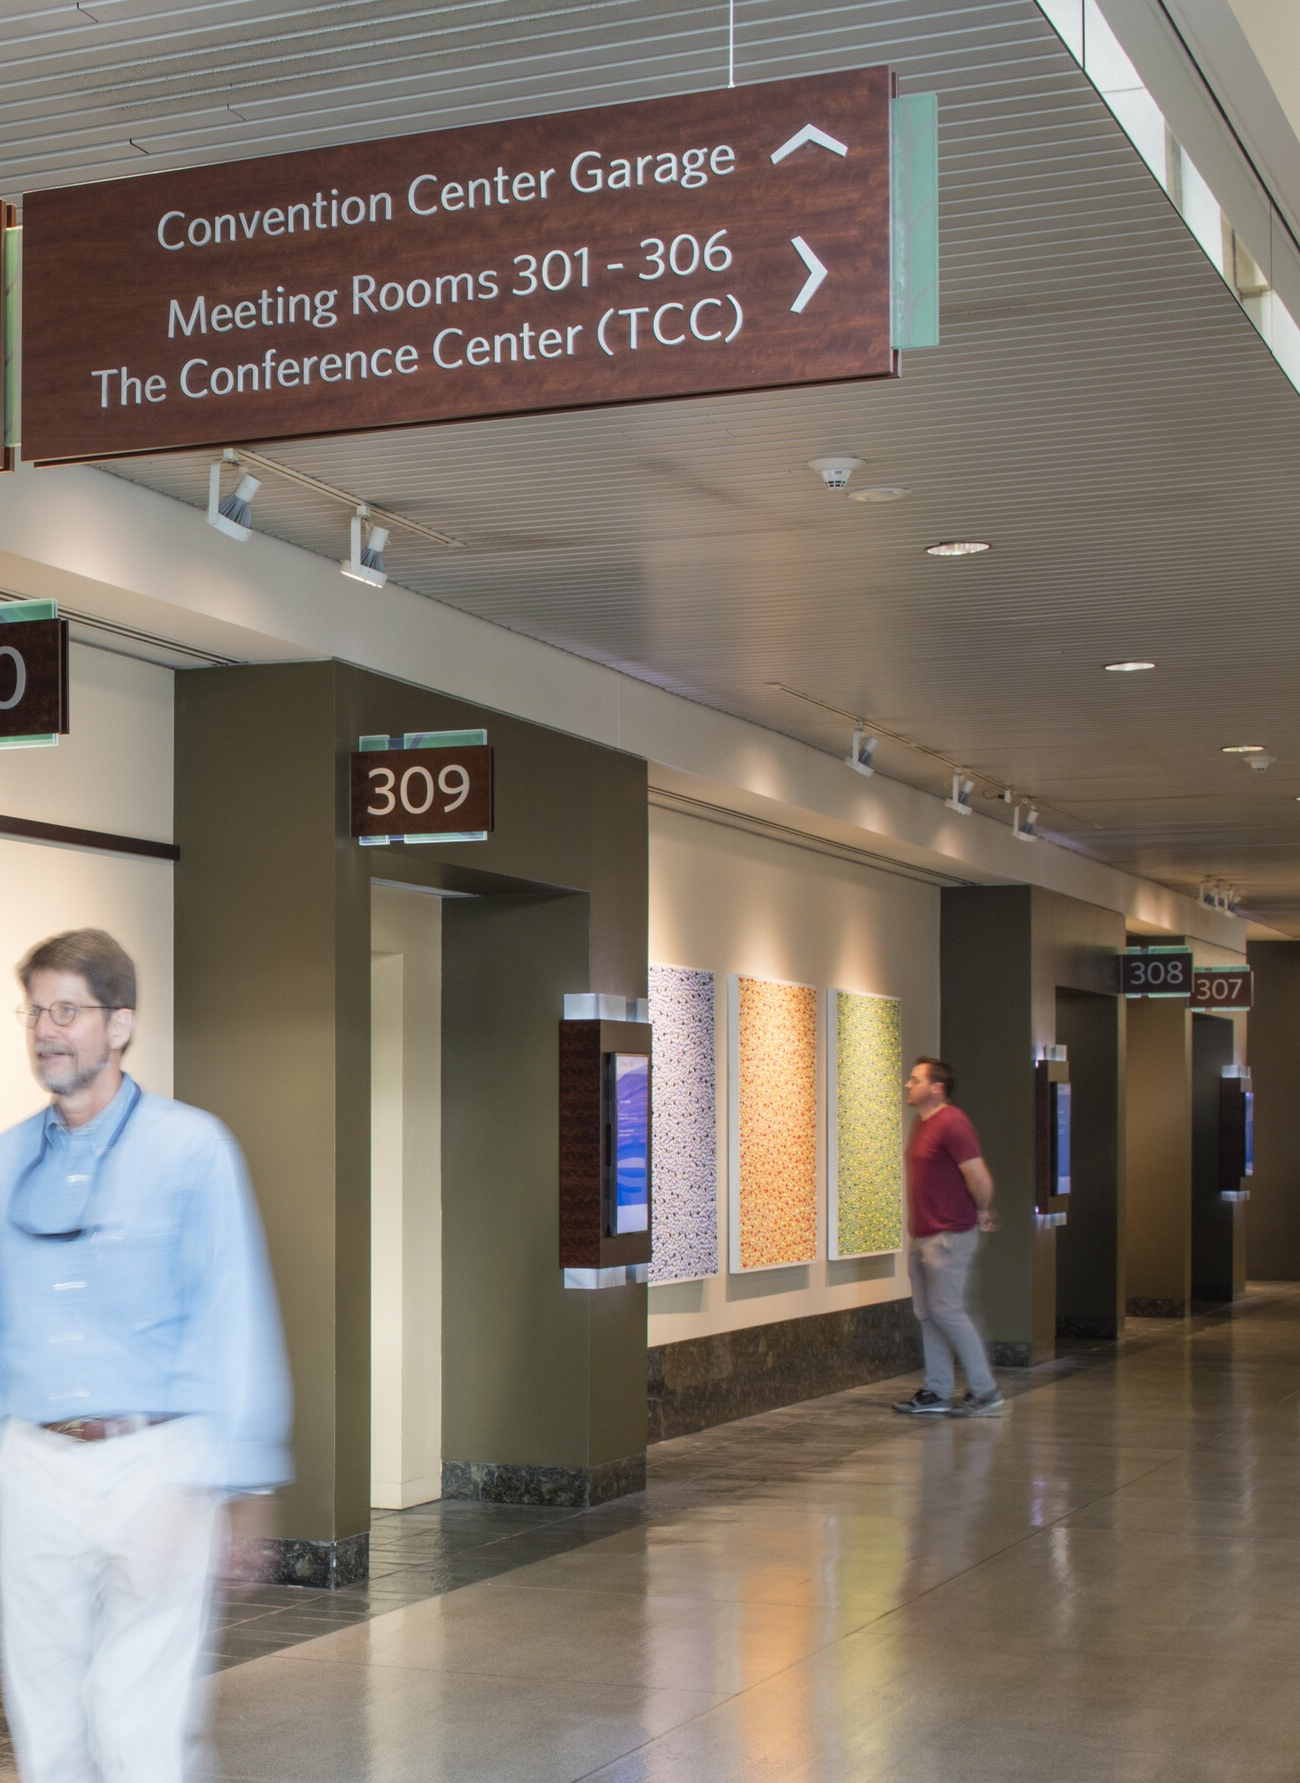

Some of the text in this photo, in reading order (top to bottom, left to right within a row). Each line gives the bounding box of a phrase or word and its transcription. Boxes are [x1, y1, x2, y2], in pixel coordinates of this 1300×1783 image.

[157, 144, 737, 251] Convention Center Garage
[167, 228, 734, 339] Meeting Rooms 301 - 306
[91, 292, 745, 409] The Conference Center (TCC)
[366, 764, 471, 816] 309
[1129, 961, 1185, 985] 308
[1196, 978, 1244, 1000] 307
